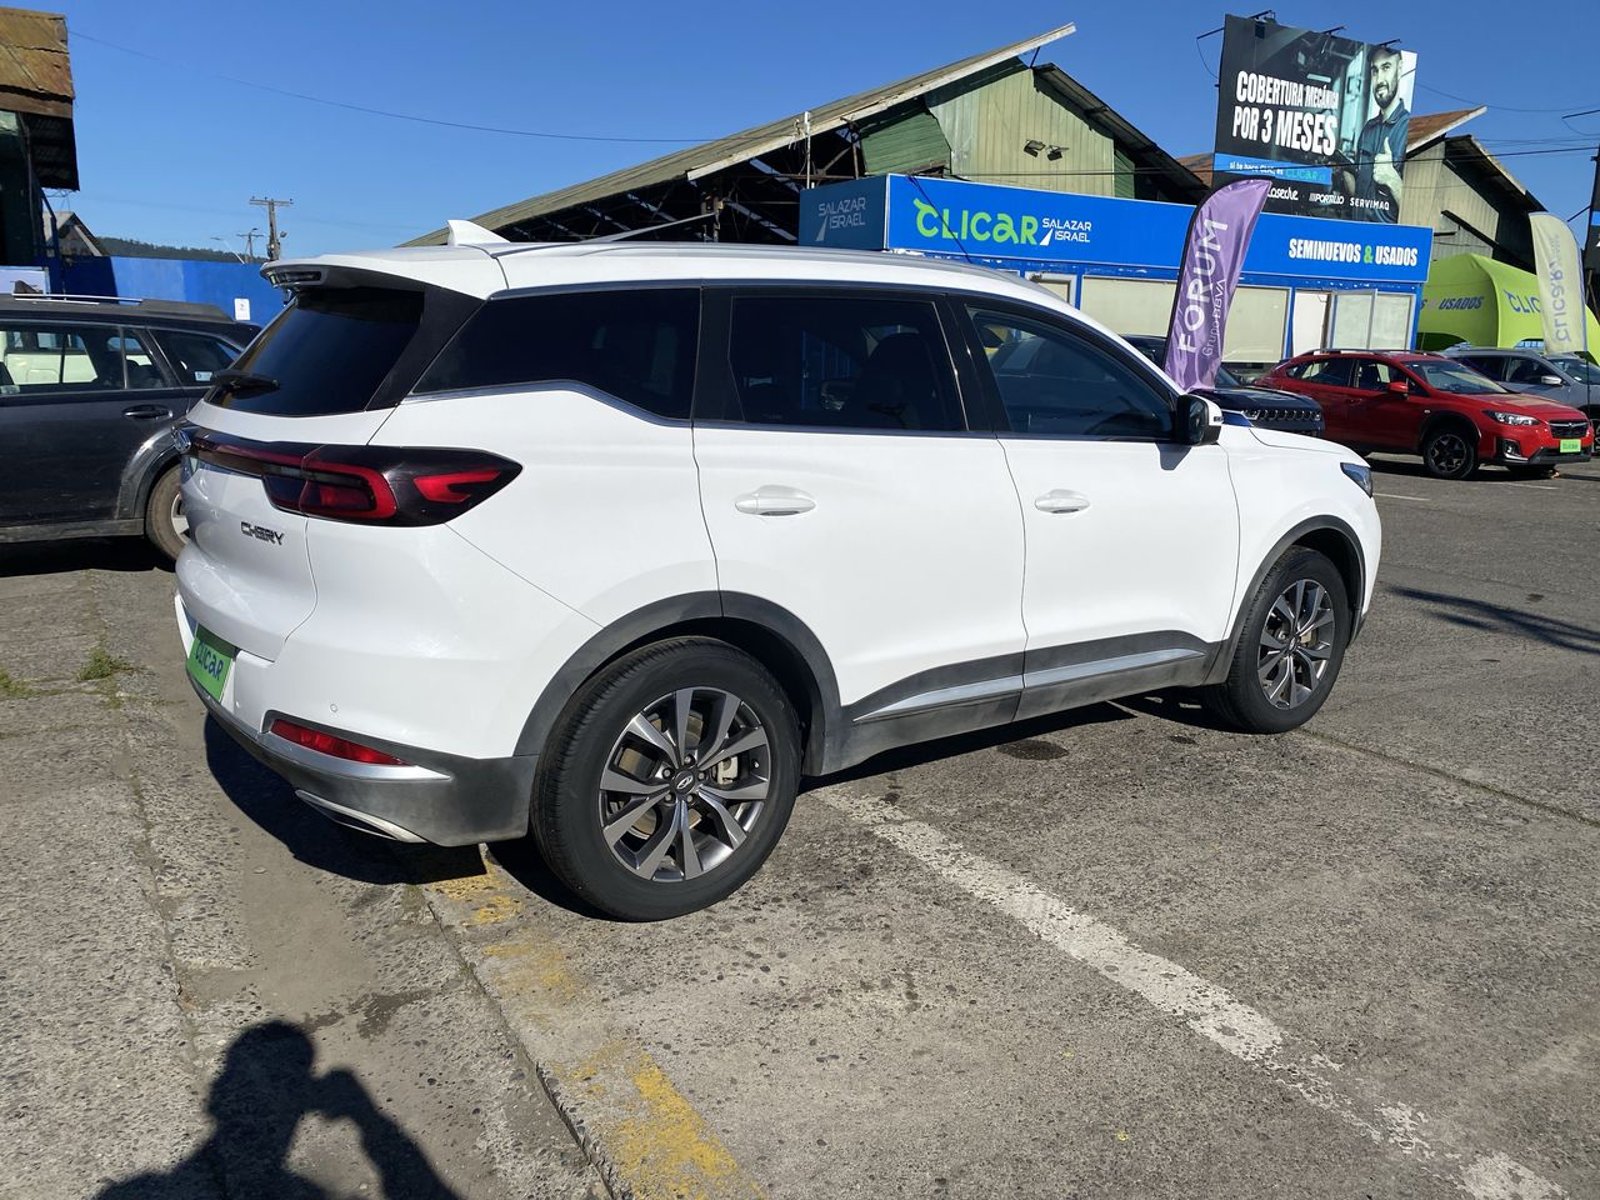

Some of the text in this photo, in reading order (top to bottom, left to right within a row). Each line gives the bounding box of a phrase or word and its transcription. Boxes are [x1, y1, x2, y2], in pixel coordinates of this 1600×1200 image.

[1236, 71, 1304, 107] COBERTURA
[1232, 106, 1338, 156] POR 3 MESES
[818, 197, 866, 217] SALAZAR
[1349, 197, 1390, 211] SERVIMAQ
[829, 212, 866, 229] ISRAEL
[1042, 218, 1092, 231] SALAZAR
[1054, 231, 1091, 243] ISRAEL
[1288, 238, 1418, 266] SEMINUEVOS & USADOS
[1177, 219, 1229, 354] FORUM
[240, 521, 285, 545] CHERY
